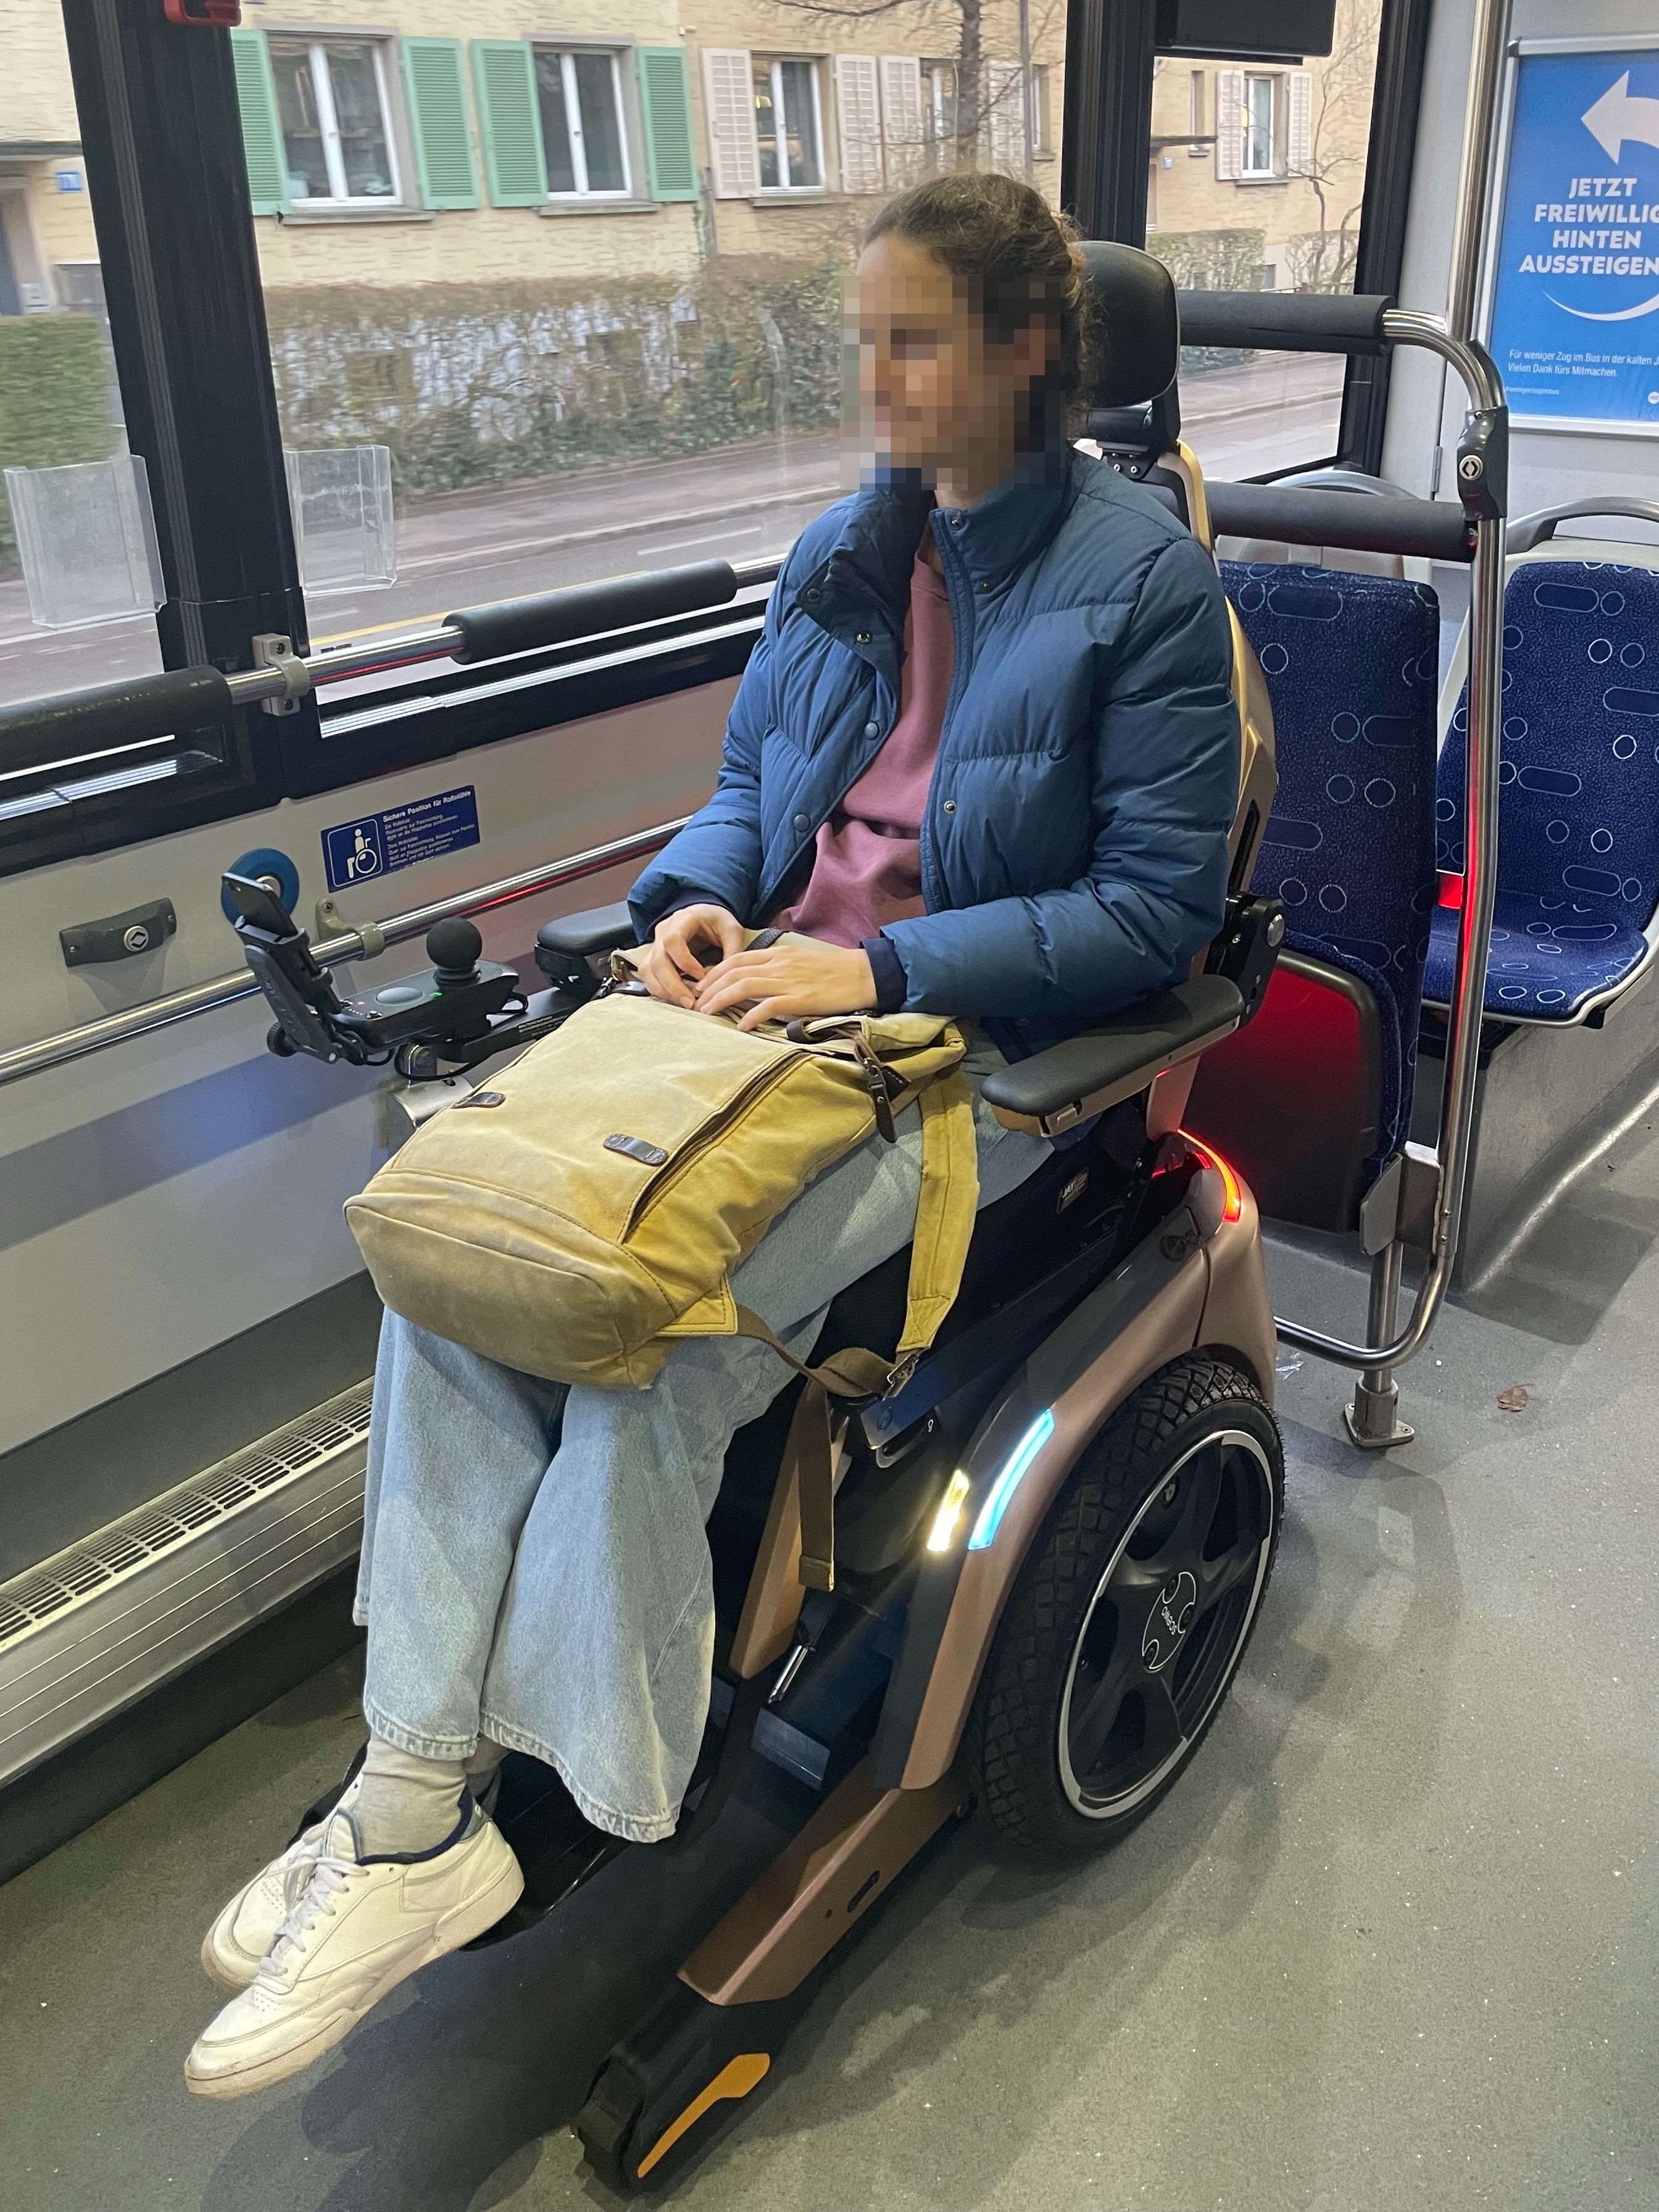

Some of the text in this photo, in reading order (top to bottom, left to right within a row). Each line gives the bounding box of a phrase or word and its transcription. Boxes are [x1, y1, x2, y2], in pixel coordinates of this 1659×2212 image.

[1569, 178, 1637, 199] JETZT
[1553, 230, 1642, 249] HINTEN
[1518, 254, 1659, 276] AUSSTEIGEN
[1509, 349, 1522, 359] Für
[1524, 351, 1555, 362] weniger
[1557, 352, 1572, 363] Zug
[1573, 352, 1583, 362] im
[1586, 353, 1600, 363] Bus
[1602, 354, 1610, 363] in
[1612, 354, 1625, 364] der
[1627, 355, 1652, 365] kalten
[1508, 362, 1618, 377] Vielen Dank fürs Mitmachen.
[383, 811, 406, 823] Sichere
[407, 803, 431, 815] Position
[433, 799, 442, 807] für
